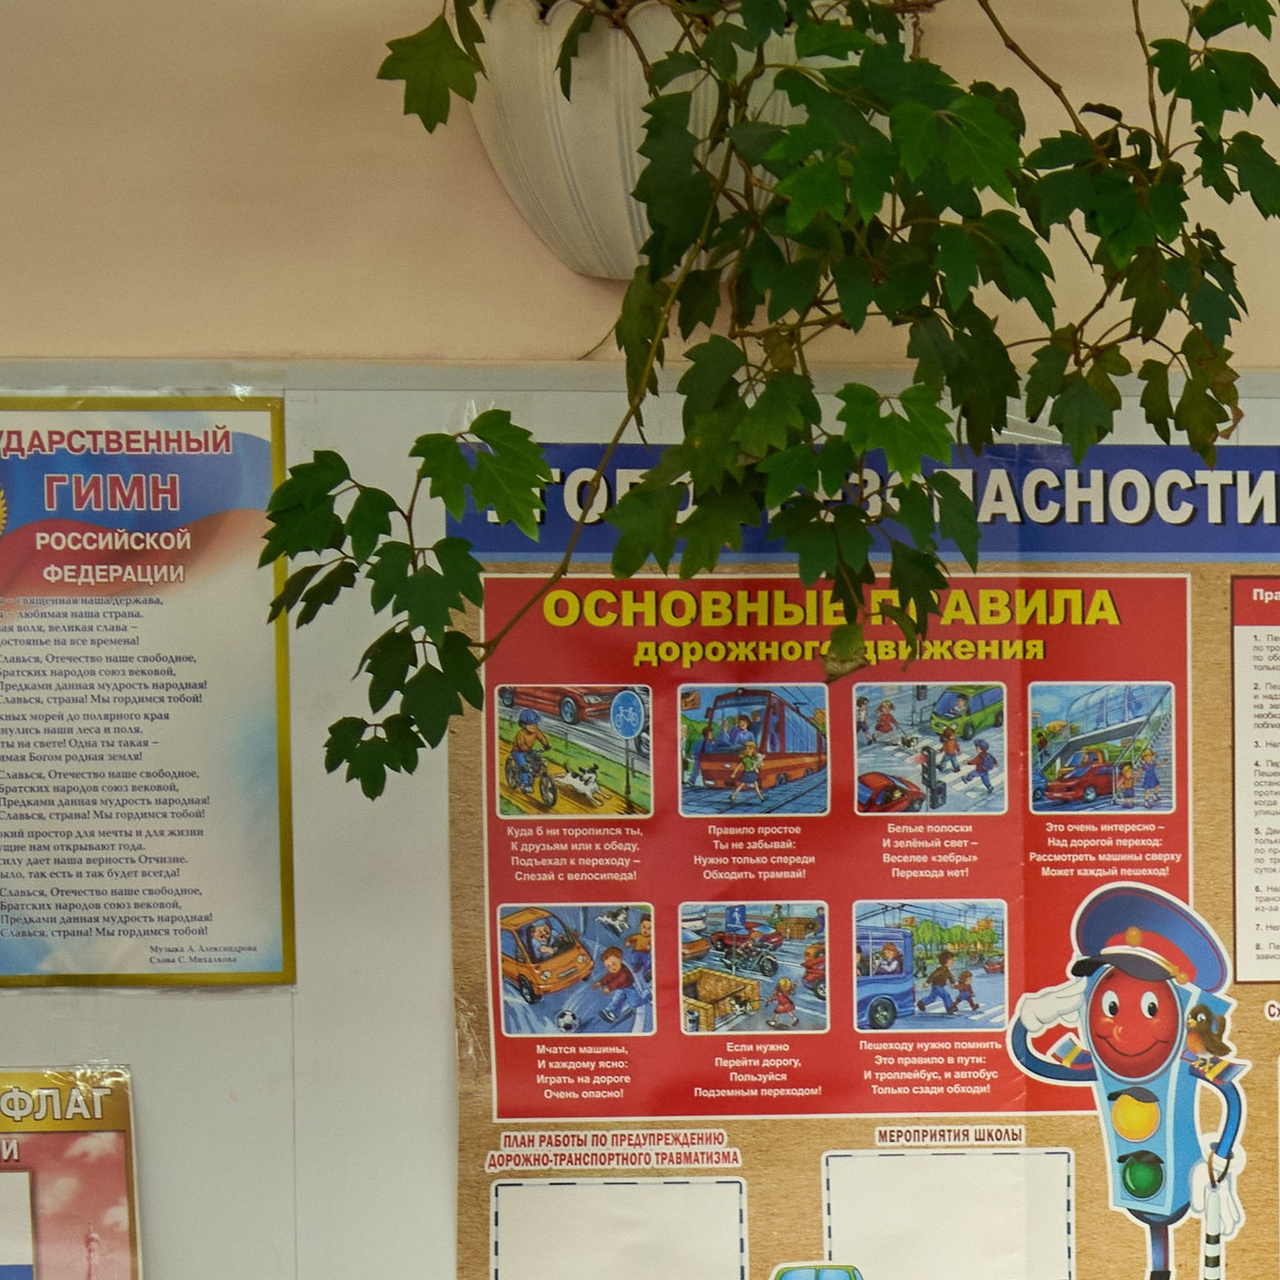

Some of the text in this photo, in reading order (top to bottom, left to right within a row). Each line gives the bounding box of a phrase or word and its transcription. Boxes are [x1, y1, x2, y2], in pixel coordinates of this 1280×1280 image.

[45, 474, 180, 511] ГИМН
[36, 528, 190, 550] РОССИЙСКОЙ
[42, 564, 186, 586] ФЕДЕРАЦИИ
[1254, 740, 1261, 748] 3.
[708, 824, 801, 836] Правило простое
[1046, 822, 1064, 832] Это
[1066, 824, 1098, 832] очень
[1100, 823, 1156, 833] интересно
[712, 839, 796, 849] Ты не забывай:
[1047, 836, 1162, 848] Над дорогой переход:
[693, 855, 815, 866] Нужно только спереди
[1029, 851, 1181, 863] Рассмотреть машины сверху
[702, 869, 806, 880] Обходить трамвай!
[1041, 866, 1169, 877] Может каждый пешеход!
[0, 885, 202, 897] Славься, Отечество наше свободное,
[0, 900, 181, 912] Братских народов союз вековой,
[0, 925, 208, 939] Славься, страна! Мы гордимся тобой!
[726, 1041, 789, 1053] Если нужно
[714, 1057, 801, 1069] Перейти дорогу,
[729, 1071, 786, 1083] Пользуйся
[694, 1086, 821, 1097] Подземным переходом!
[0, 1087, 112, 1122] ФЛАГ
[503, 1132, 724, 1147] ПЛАН РАБОТЫ ПО ПРЕДУПРЕЖДЕНИЮ
[878, 1128, 1021, 1142] МЕРОПРИЯТИЯ ШКОЛЫ
[488, 1150, 739, 1169] ДОРОЖНО-ТРАНСПОРТНОГО ТРАВМАТИЗМА
